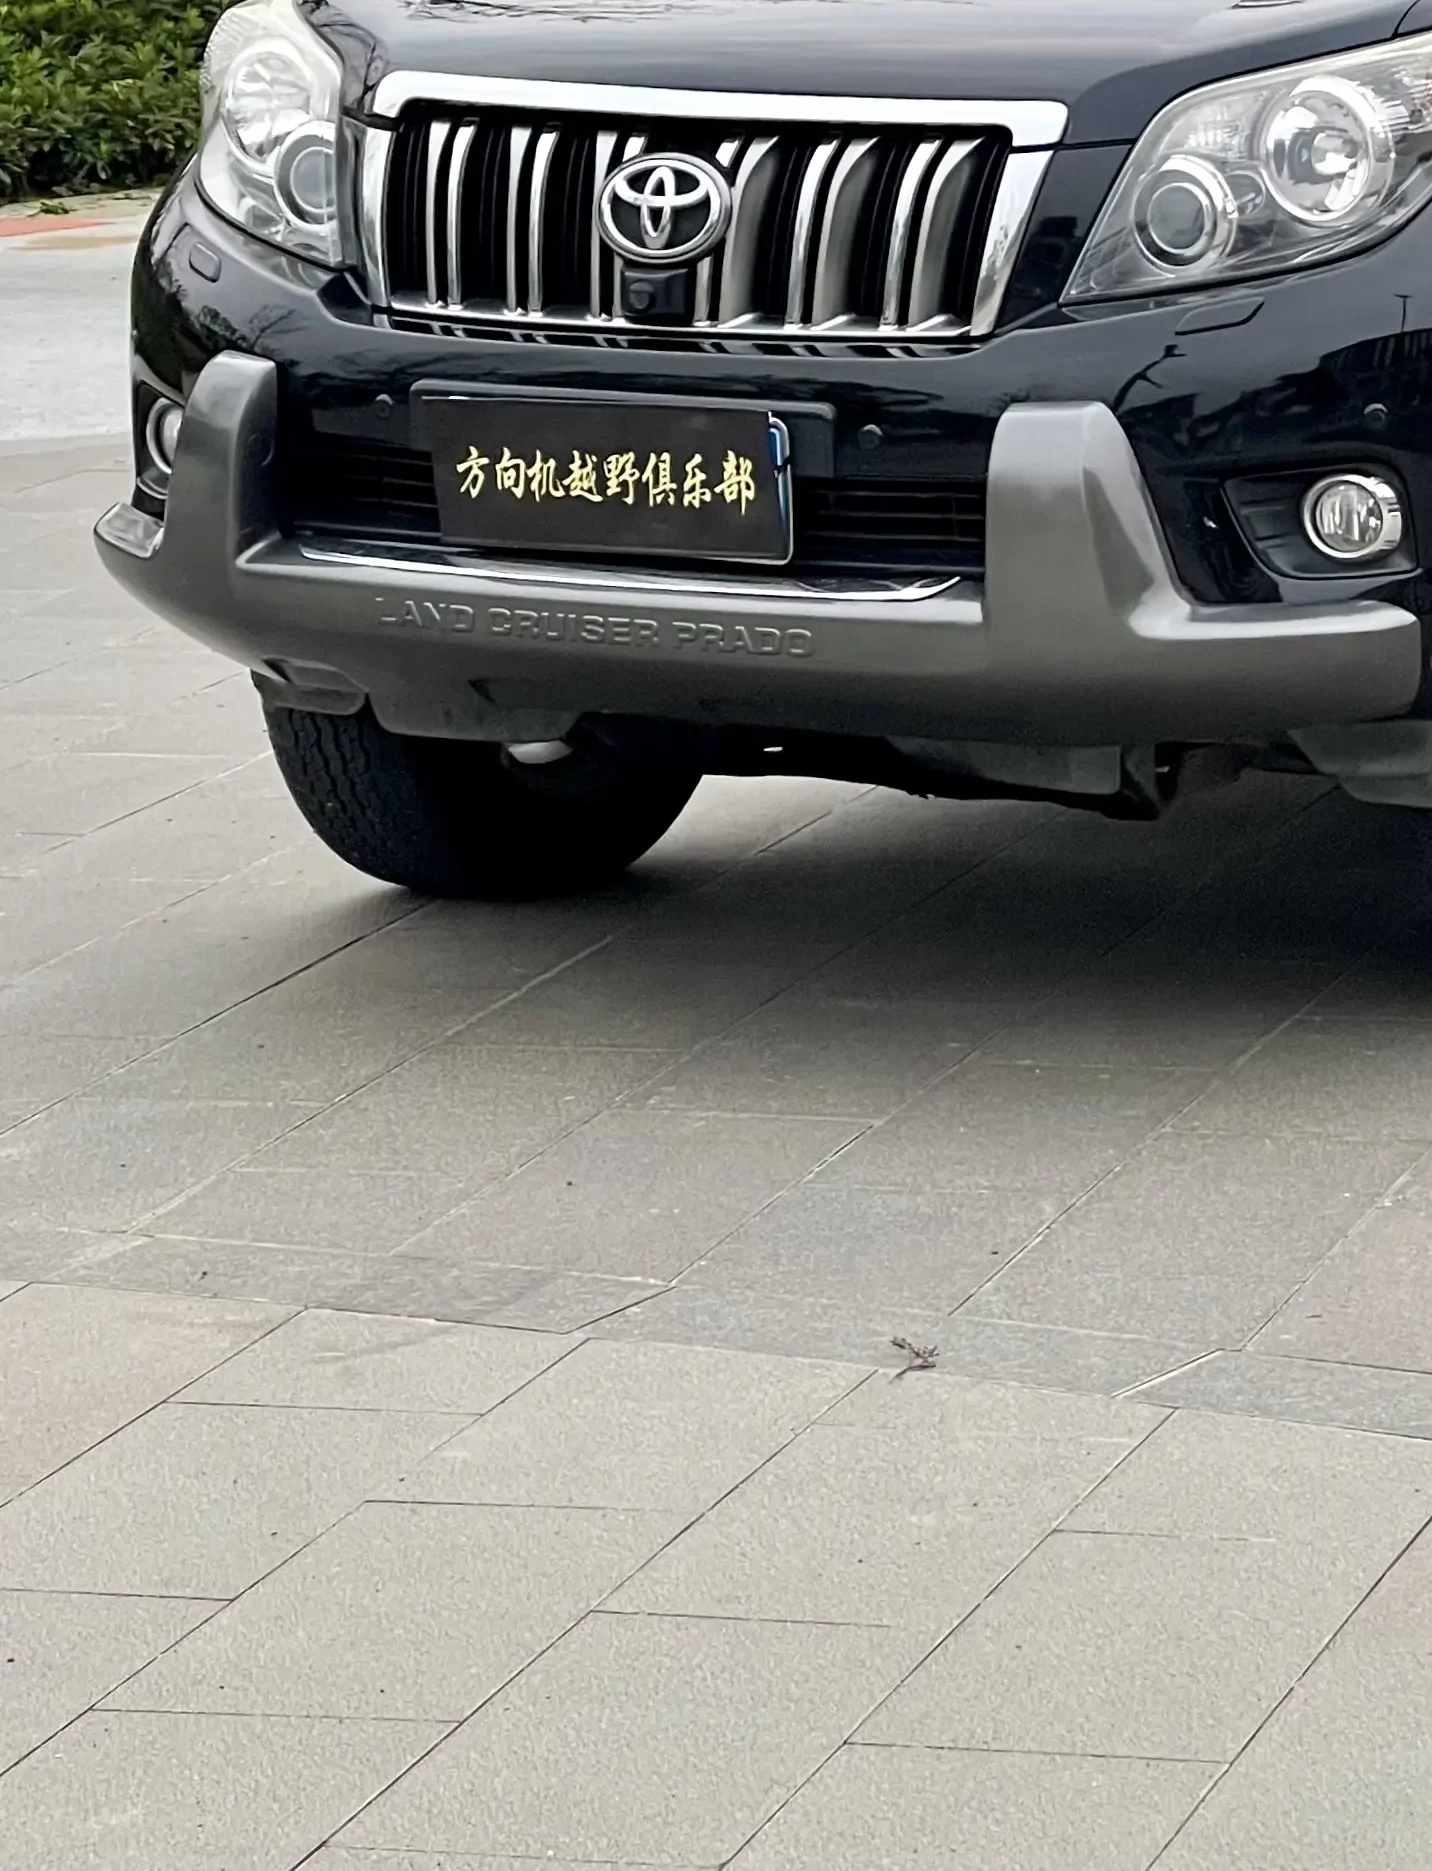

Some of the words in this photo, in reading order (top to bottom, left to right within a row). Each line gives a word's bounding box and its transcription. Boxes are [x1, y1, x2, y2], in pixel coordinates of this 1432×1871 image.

[456, 445, 756, 516] 方向机越野俱乐部
[374, 597, 476, 634] LAND
[487, 607, 659, 647] CRUISER
[672, 621, 814, 657] PRADO
